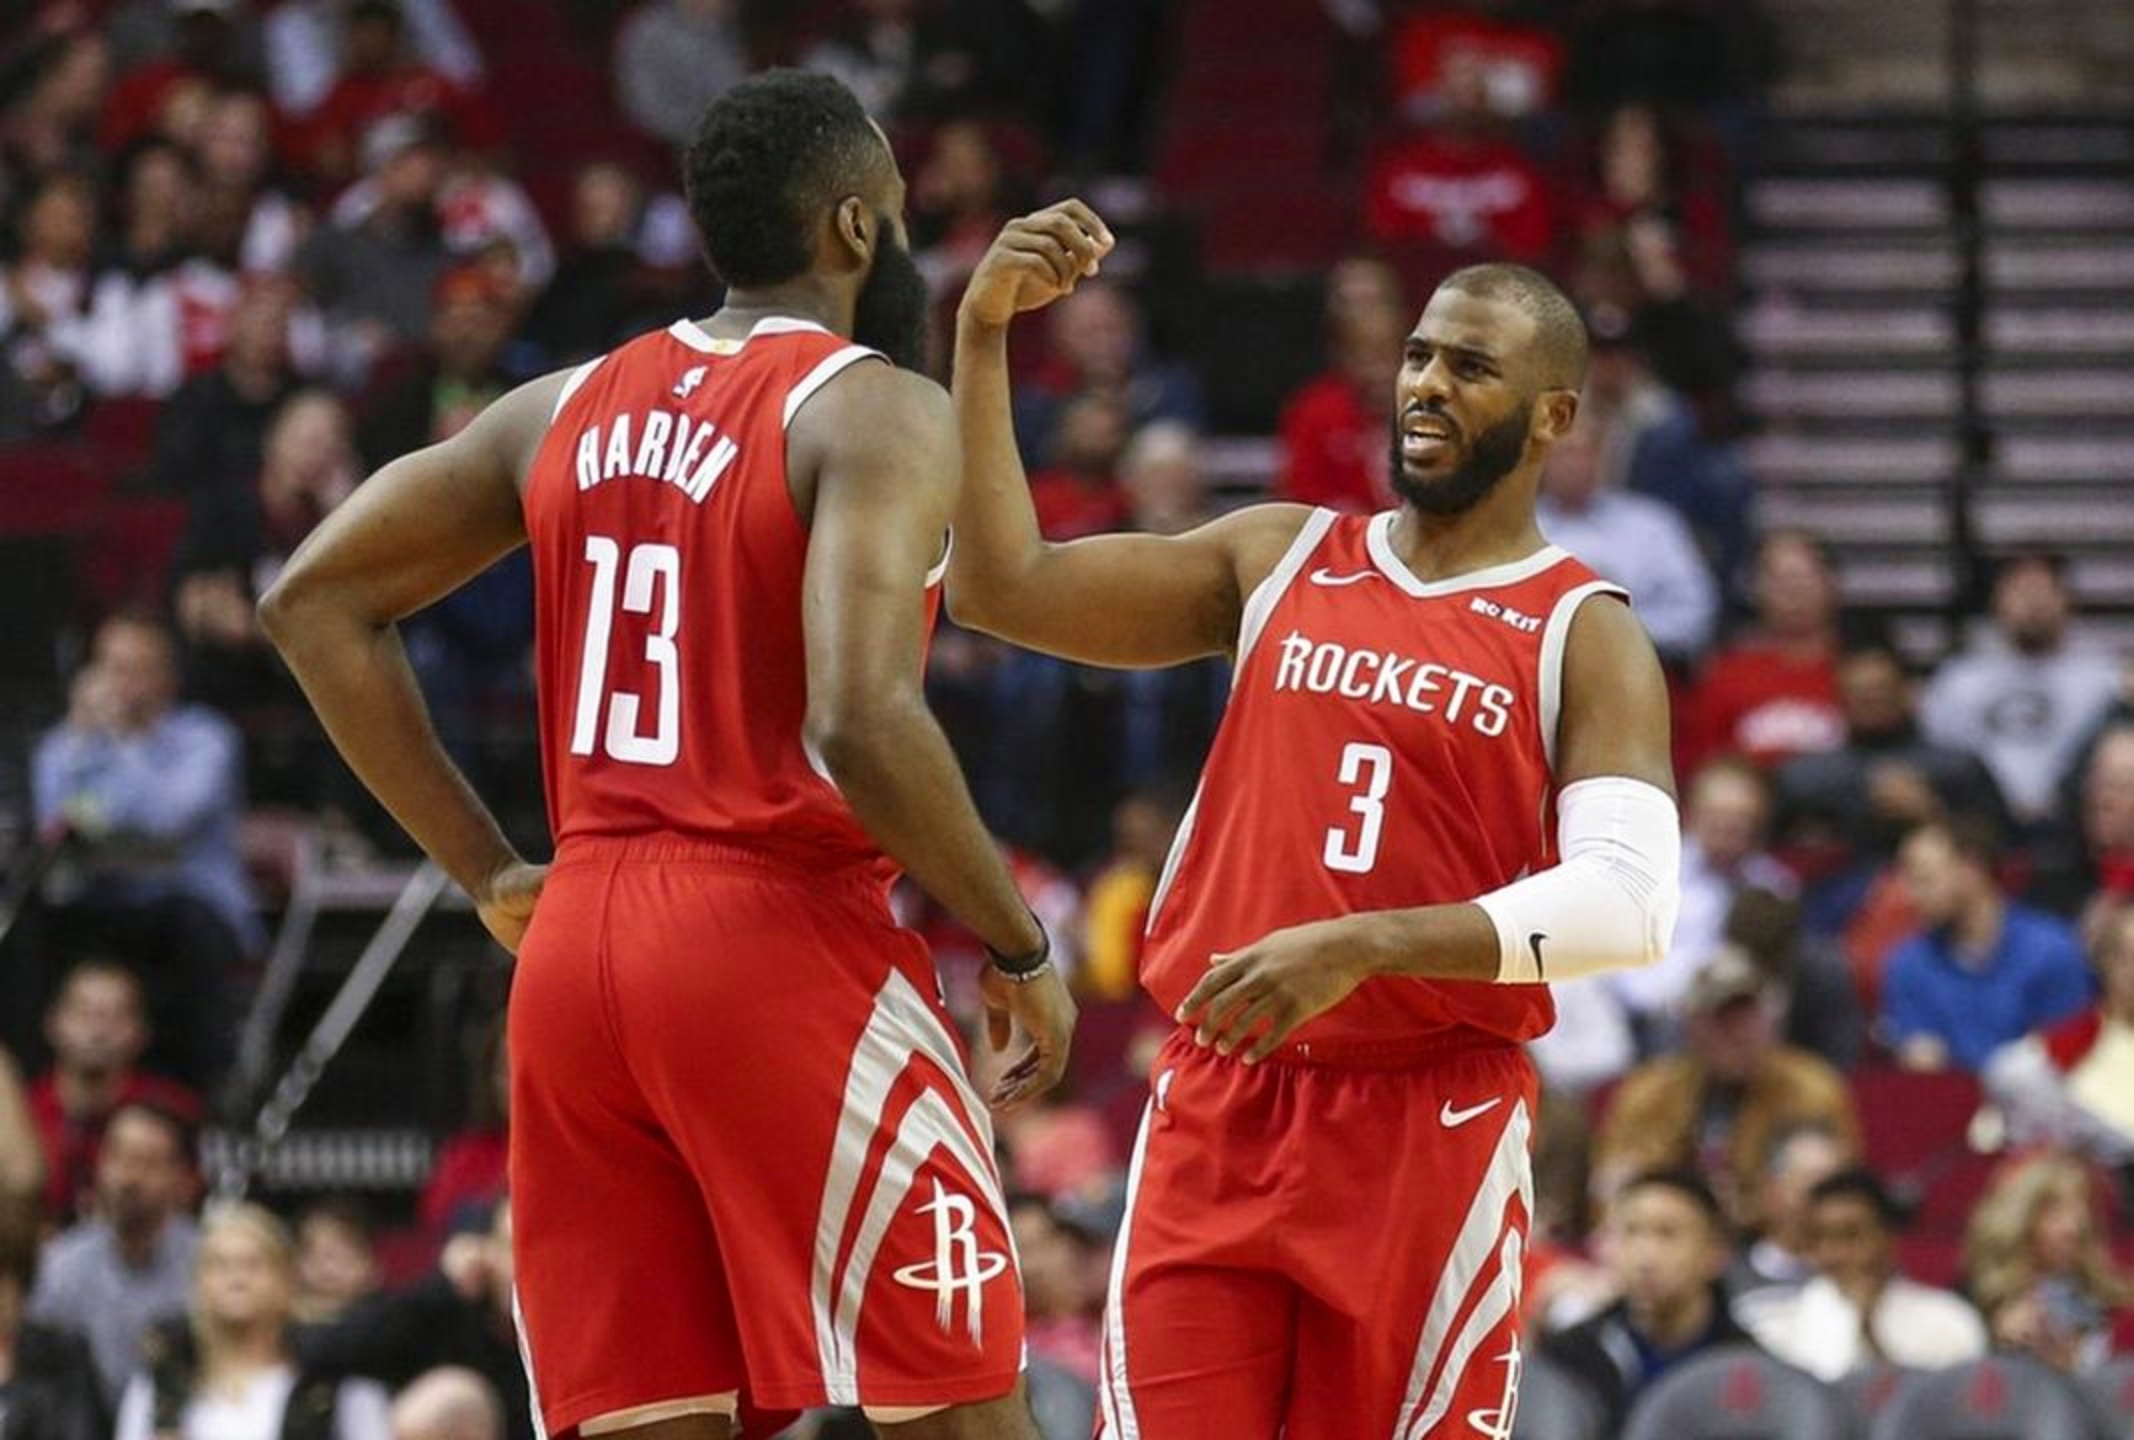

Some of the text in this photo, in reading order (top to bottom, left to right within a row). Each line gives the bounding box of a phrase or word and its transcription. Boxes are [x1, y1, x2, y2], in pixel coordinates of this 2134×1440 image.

[576, 410, 738, 504] HARDEN
[571, 536, 680, 766] 13
[1275, 630, 1513, 737] ROCKETS
[1323, 742, 1392, 874] 3
